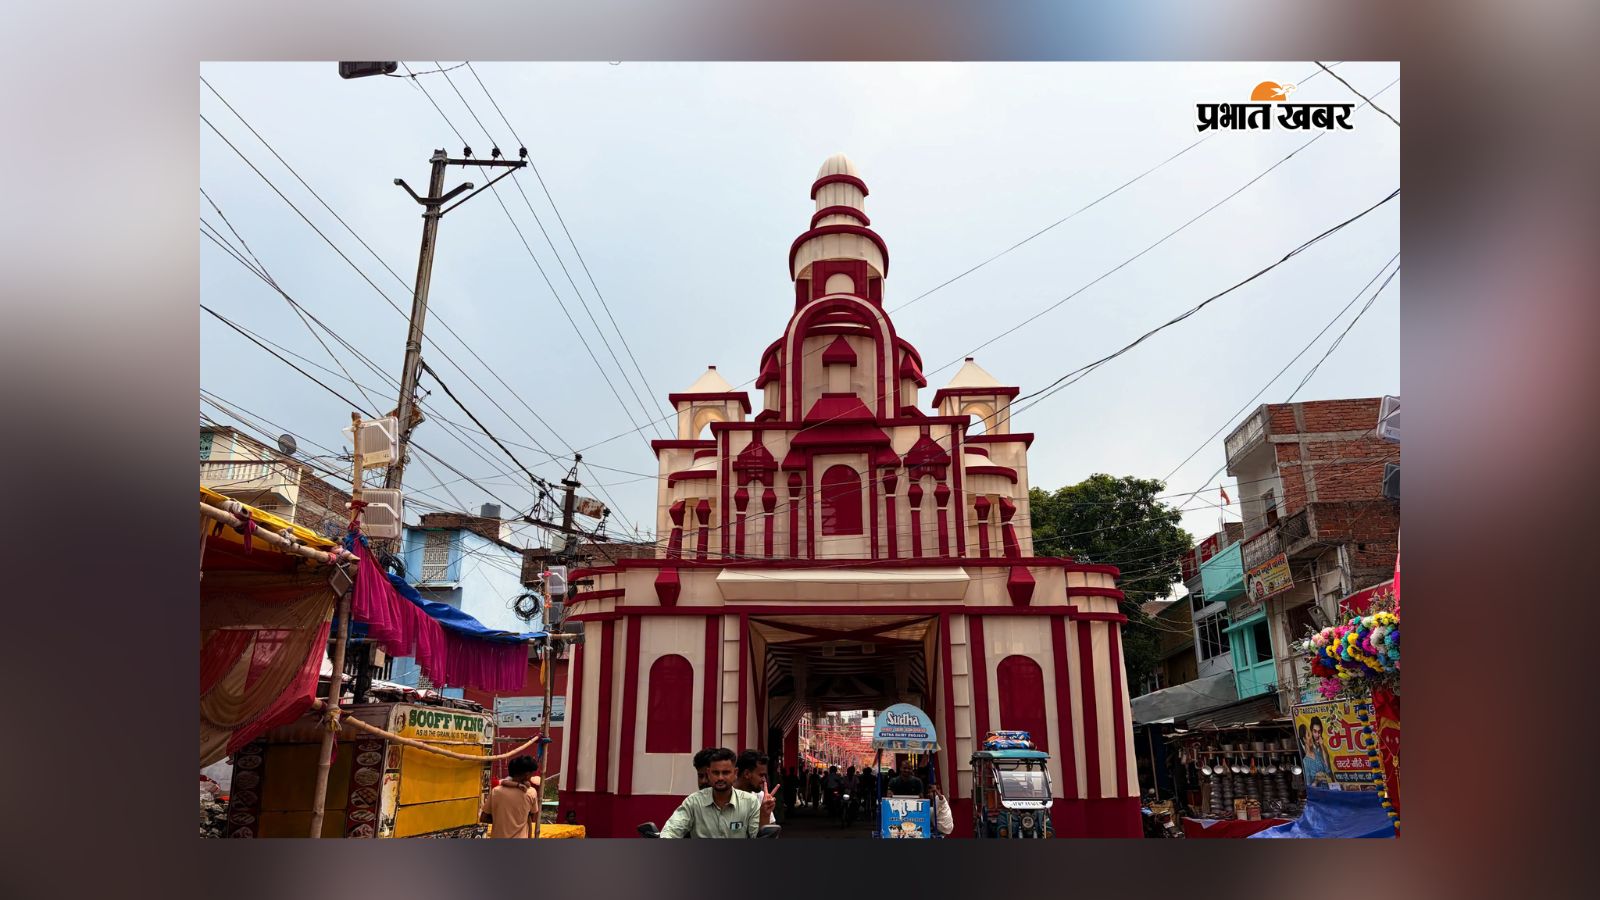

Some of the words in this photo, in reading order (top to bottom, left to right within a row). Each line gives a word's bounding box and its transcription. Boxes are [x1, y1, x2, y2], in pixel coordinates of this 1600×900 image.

[409, 709, 452, 729] SCOFF
[453, 715, 484, 732] WING
[886, 711, 920, 726] Sudha
